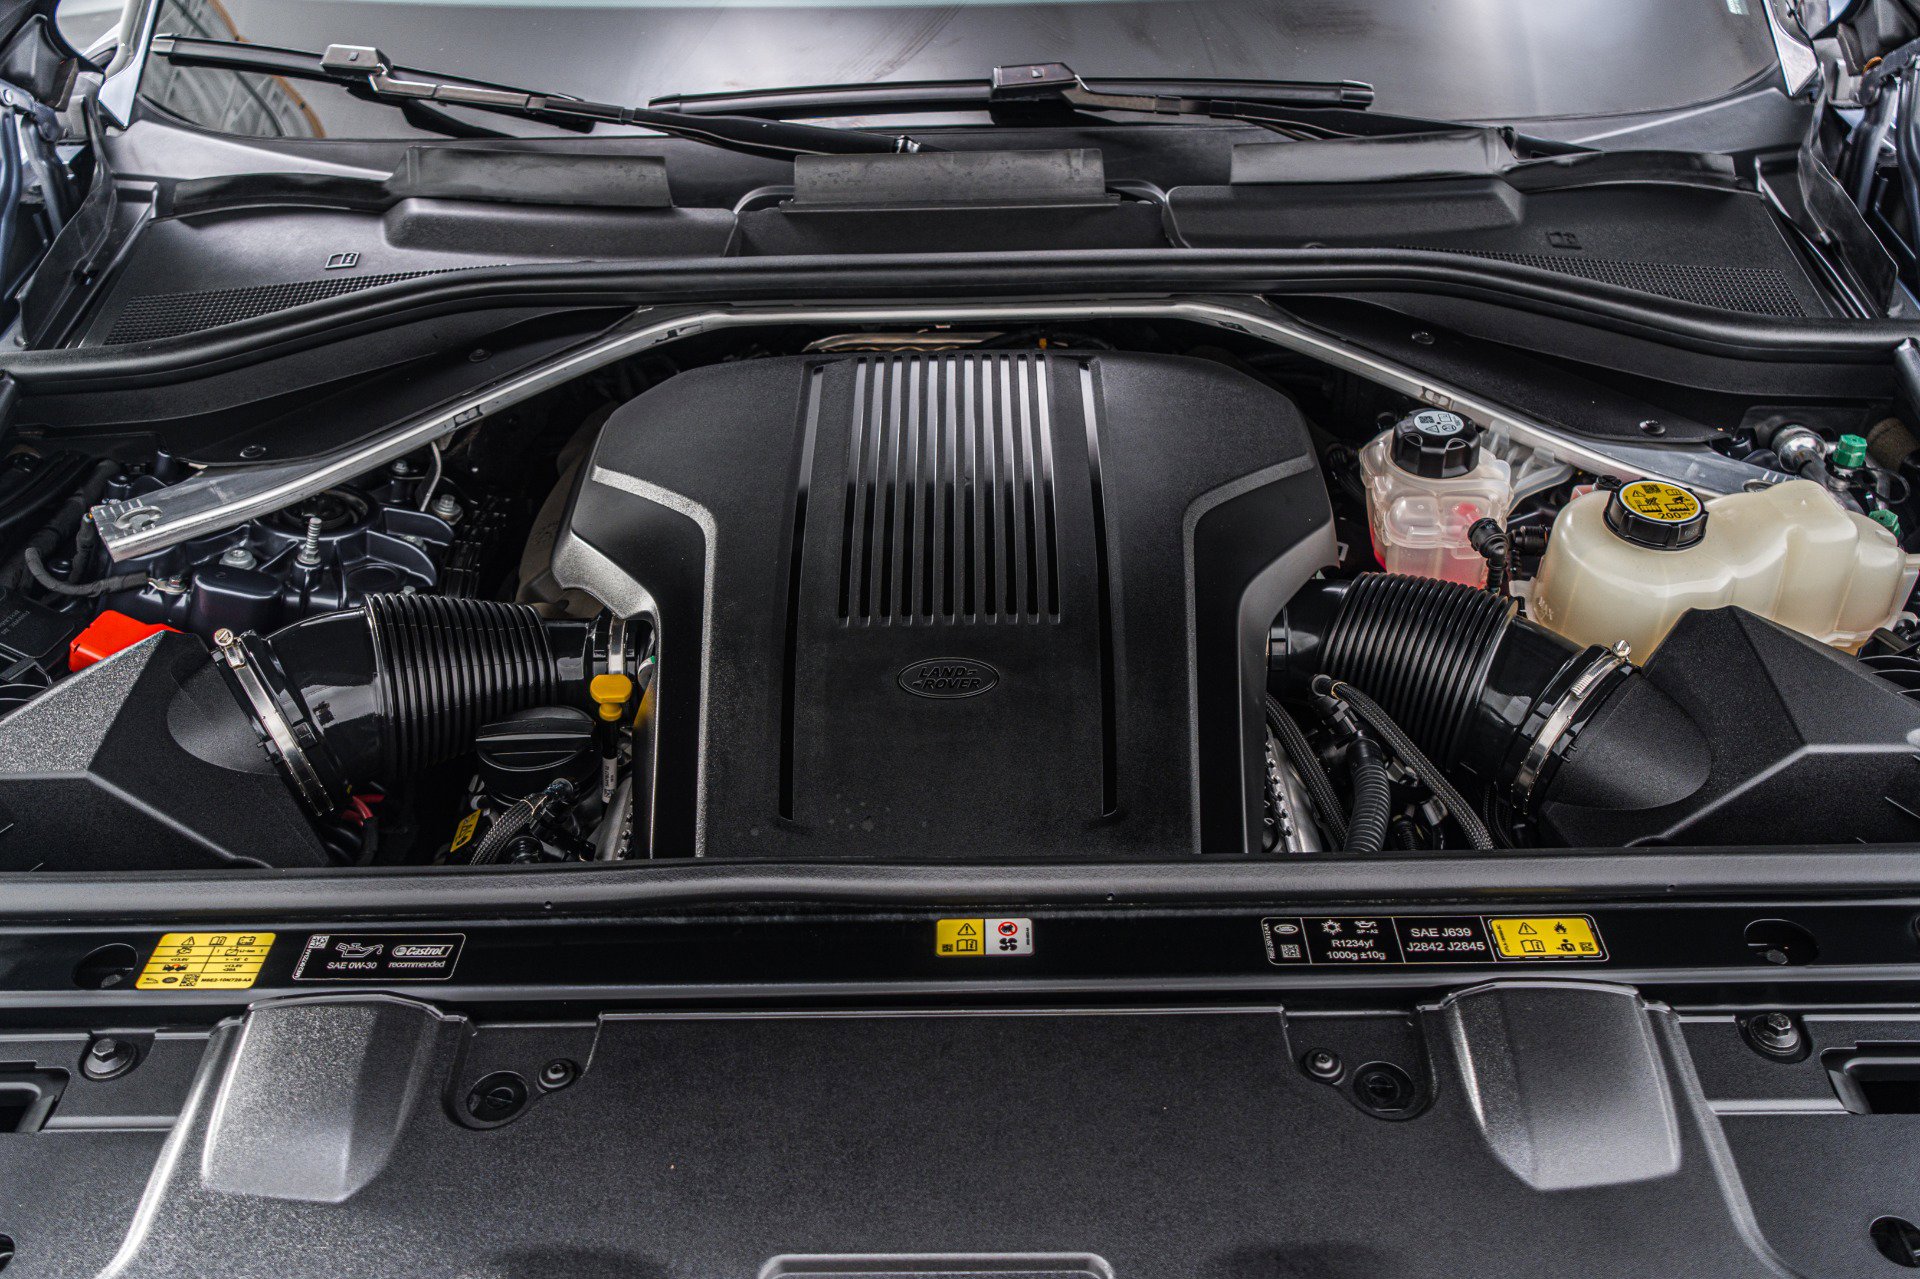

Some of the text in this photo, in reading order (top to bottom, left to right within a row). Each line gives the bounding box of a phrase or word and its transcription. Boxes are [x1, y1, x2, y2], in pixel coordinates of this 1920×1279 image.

[1657, 511, 1682, 520] 200
[918, 665, 968, 678] LAND
[921, 677, 982, 689] ROVER
[1410, 927, 1472, 937] SAE J639
[1330, 939, 1375, 949] R1234yf
[1405, 941, 1486, 952] J2842 J2845
[405, 945, 444, 956] Castrol
[1326, 950, 1387, 961] 1000g ±10g
[326, 961, 378, 970] SAE 0W-30
[388, 960, 446, 969] recommended
